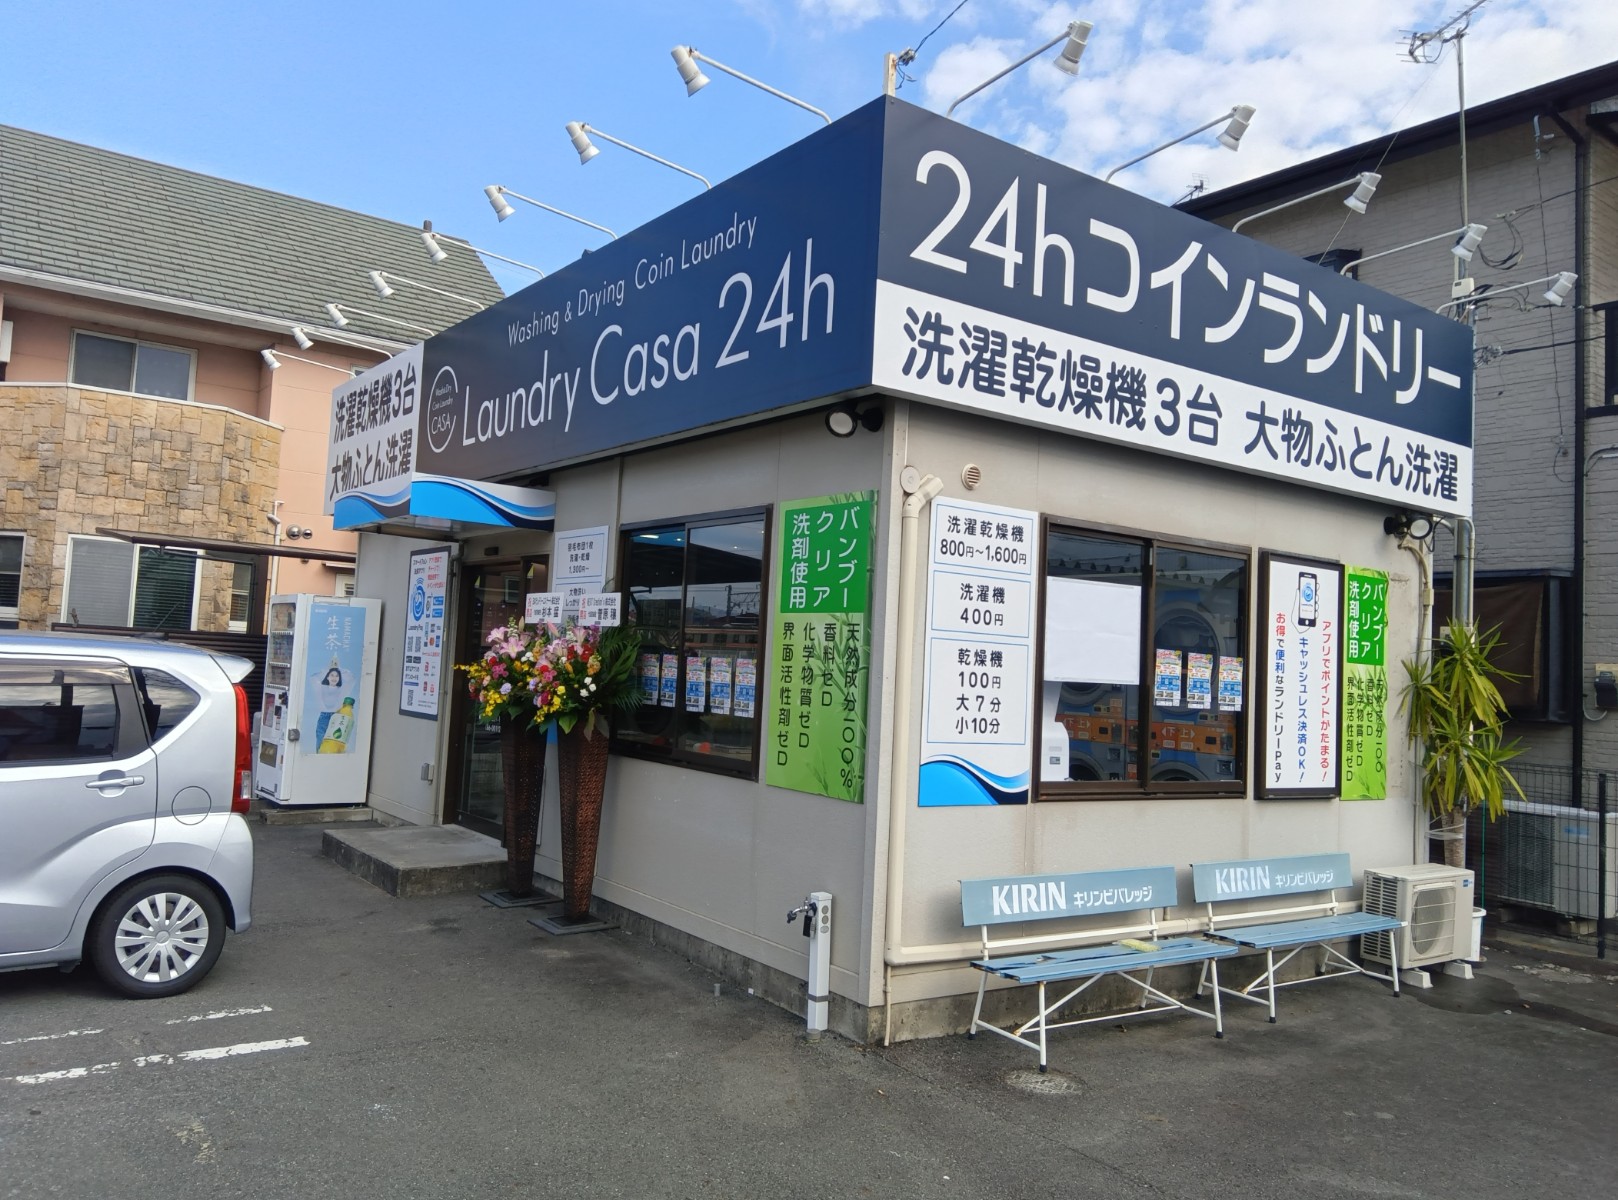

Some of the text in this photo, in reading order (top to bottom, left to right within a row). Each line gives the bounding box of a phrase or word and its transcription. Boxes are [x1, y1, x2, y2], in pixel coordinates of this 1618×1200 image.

[507, 211, 758, 349] Washing & Drying Coin Laundry
[910, 150, 1461, 405] 24hコインランドリー
[462, 238, 834, 447] Laundry Casa 24h
[333, 361, 417, 444] 洗濯乾燥機3台
[431, 412, 451, 435] CASA
[901, 306, 1459, 503] 洗濯乾燥機3台 大物ふとん洗濯
[329, 428, 414, 502] 大物ふとん洗濯
[789, 513, 811, 610] 洗剤使用
[812, 510, 834, 608] クリア
[838, 508, 860, 609] バンブー
[946, 514, 1025, 544] 洗濯乾燥機
[959, 582, 1006, 605] 洗濯機
[960, 608, 1004, 627] 400円
[1348, 580, 1361, 659] 洗剤使用
[1360, 582, 1372, 658] クリア
[1372, 583, 1384, 660] バンブー
[325, 615, 342, 651] 生茶
[821, 622, 838, 708] 香料ゼロ
[957, 647, 1004, 669] 乾燥機
[776, 621, 795, 767] 界面活性剤ゼロ
[798, 621, 816, 749] 化学物質ゼロ
[957, 670, 1001, 690] 100円
[955, 716, 1001, 735] 小10分
[992, 880, 1153, 916] KIRIN キリンビバレッジ
[1215, 864, 1333, 895] KIRIN キリンビバレッジ
